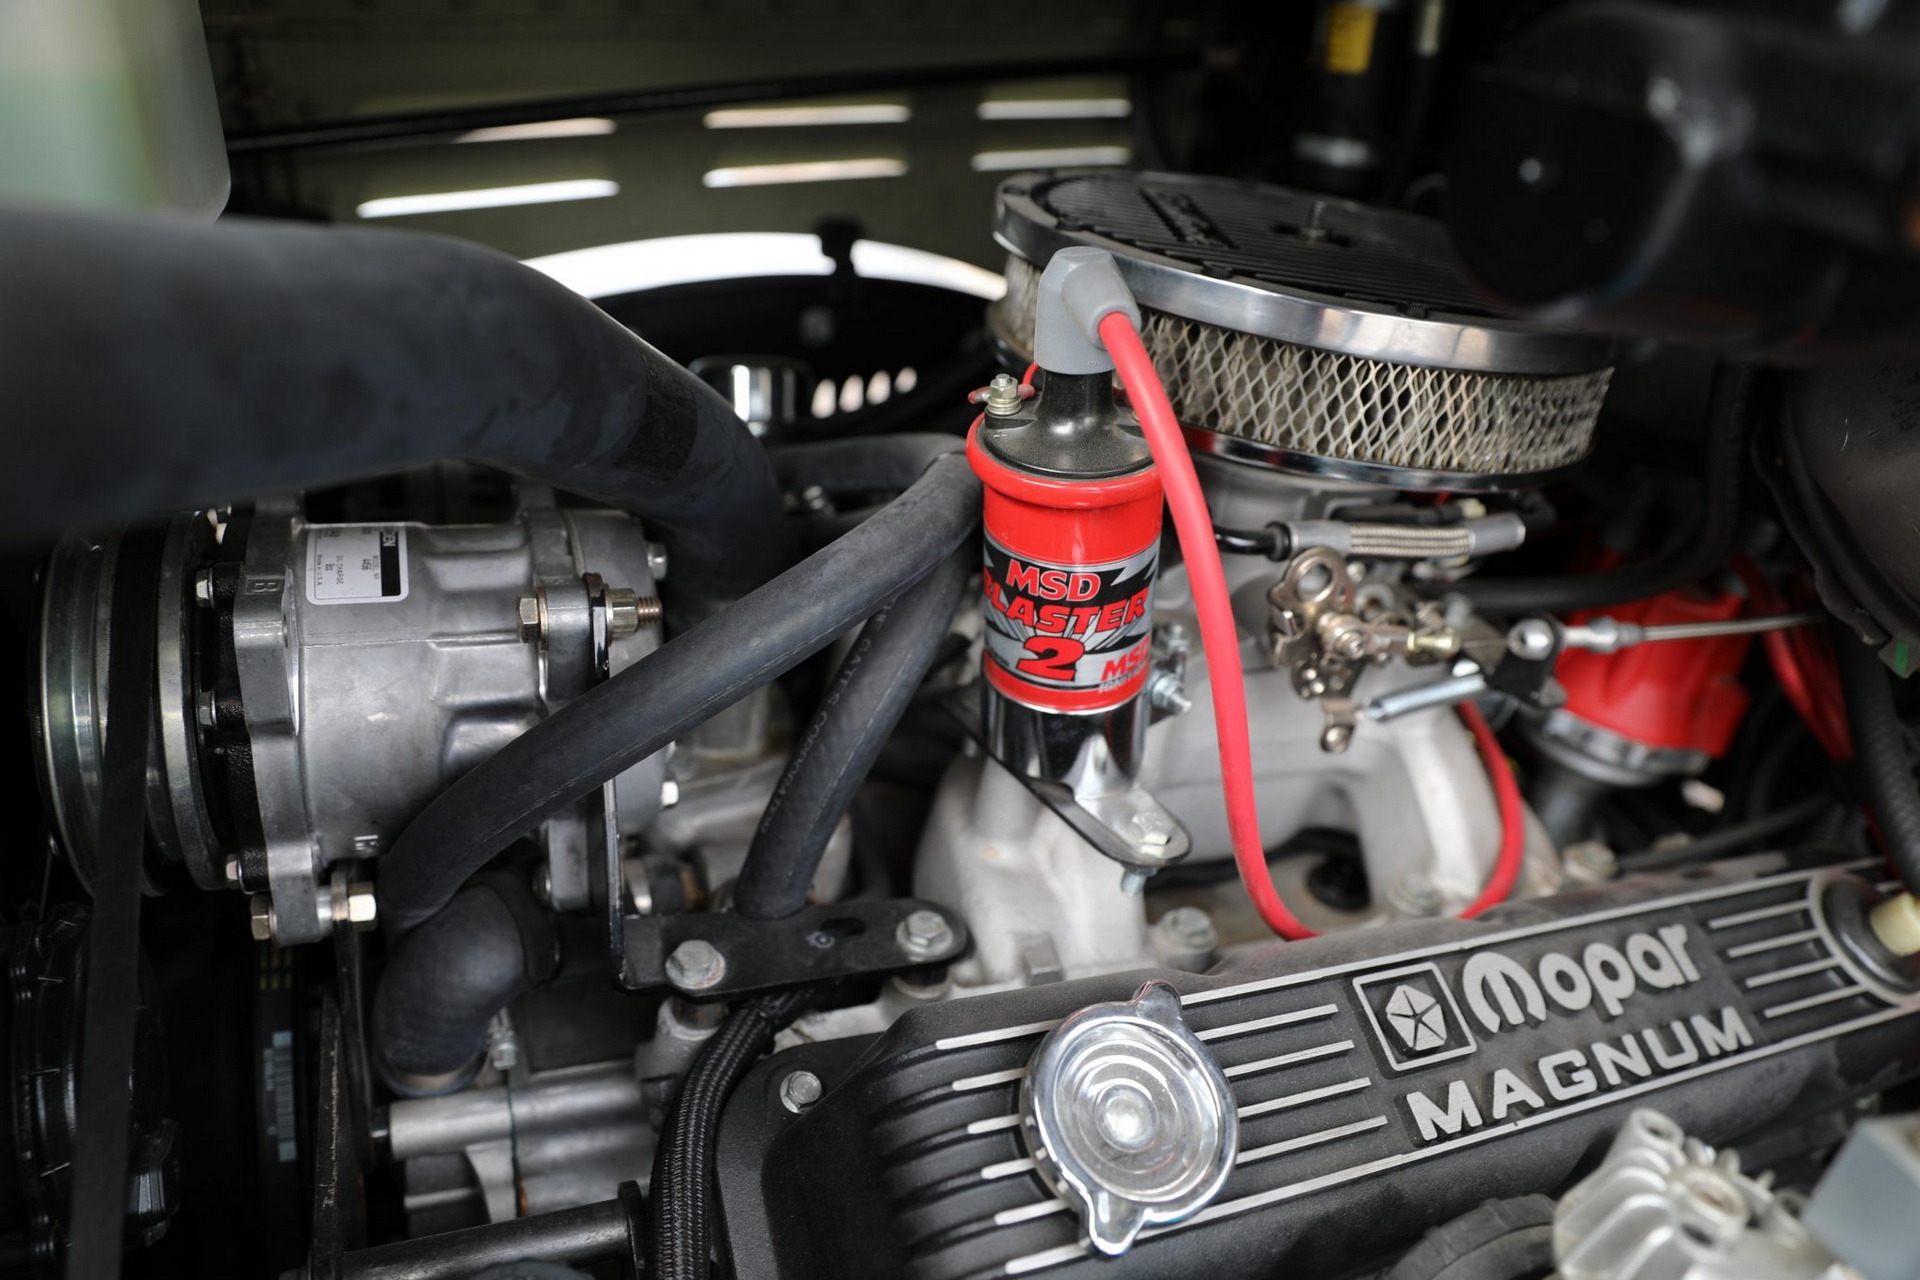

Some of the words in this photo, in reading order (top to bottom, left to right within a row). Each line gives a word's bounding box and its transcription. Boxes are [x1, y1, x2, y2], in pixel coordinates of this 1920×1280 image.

[1005, 558, 1102, 602] MSD
[827, 638, 872, 706] GATES
[1015, 634, 1086, 683] 2
[1462, 924, 1700, 1033] Mopar
[1406, 1006, 1754, 1141] MAGNUM
